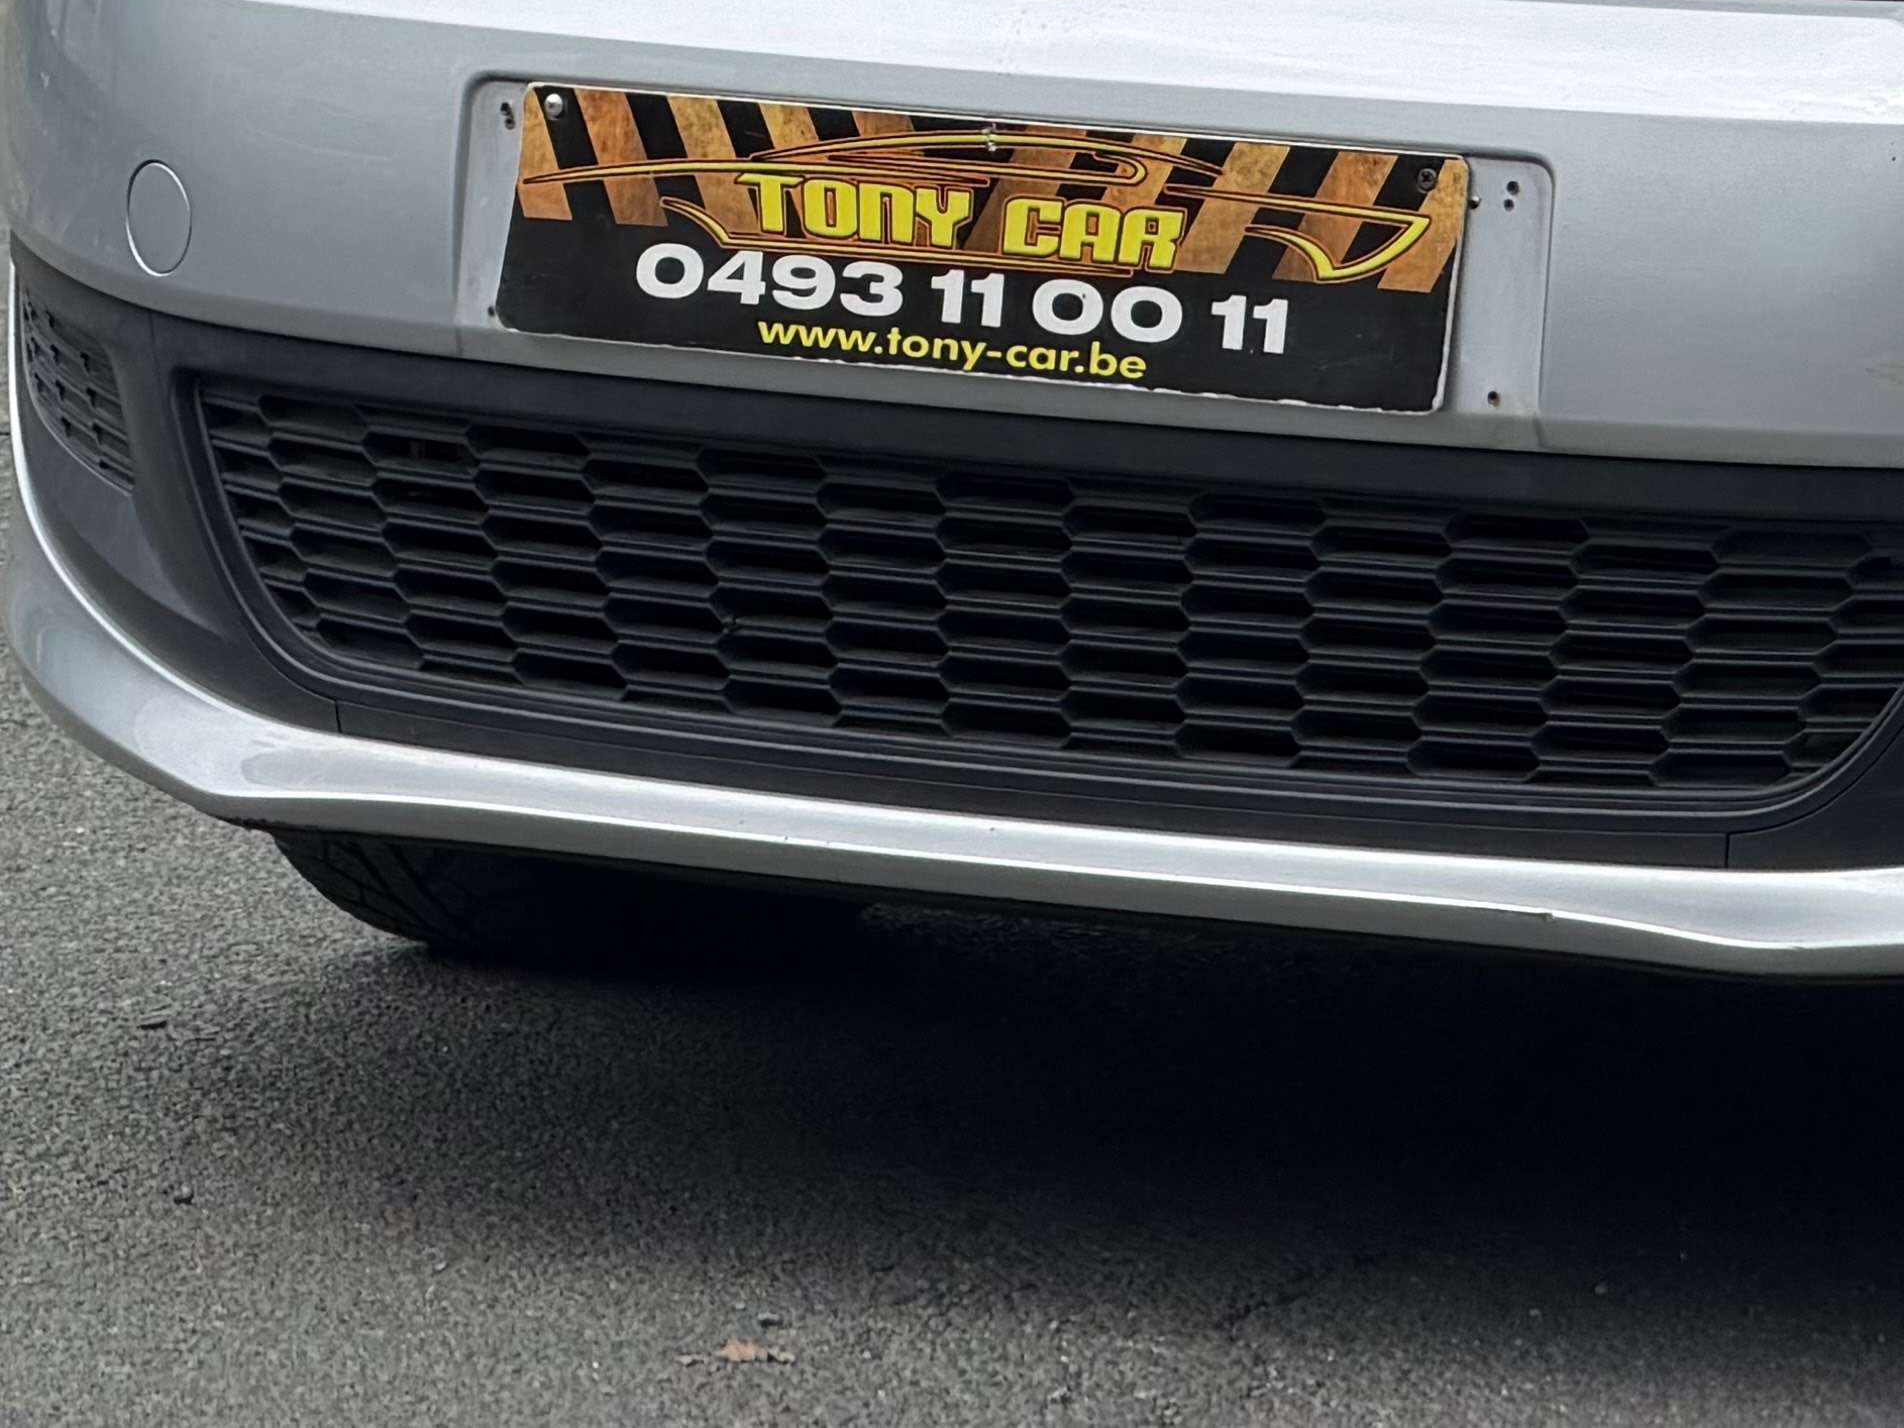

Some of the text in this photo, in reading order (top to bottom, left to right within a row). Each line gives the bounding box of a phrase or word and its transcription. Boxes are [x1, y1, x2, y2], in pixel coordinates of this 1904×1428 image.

[736, 171, 1184, 273] TONY CAR
[635, 242, 1290, 355] 0493 11 00 11
[757, 315, 1147, 381] www.tony-car.be
